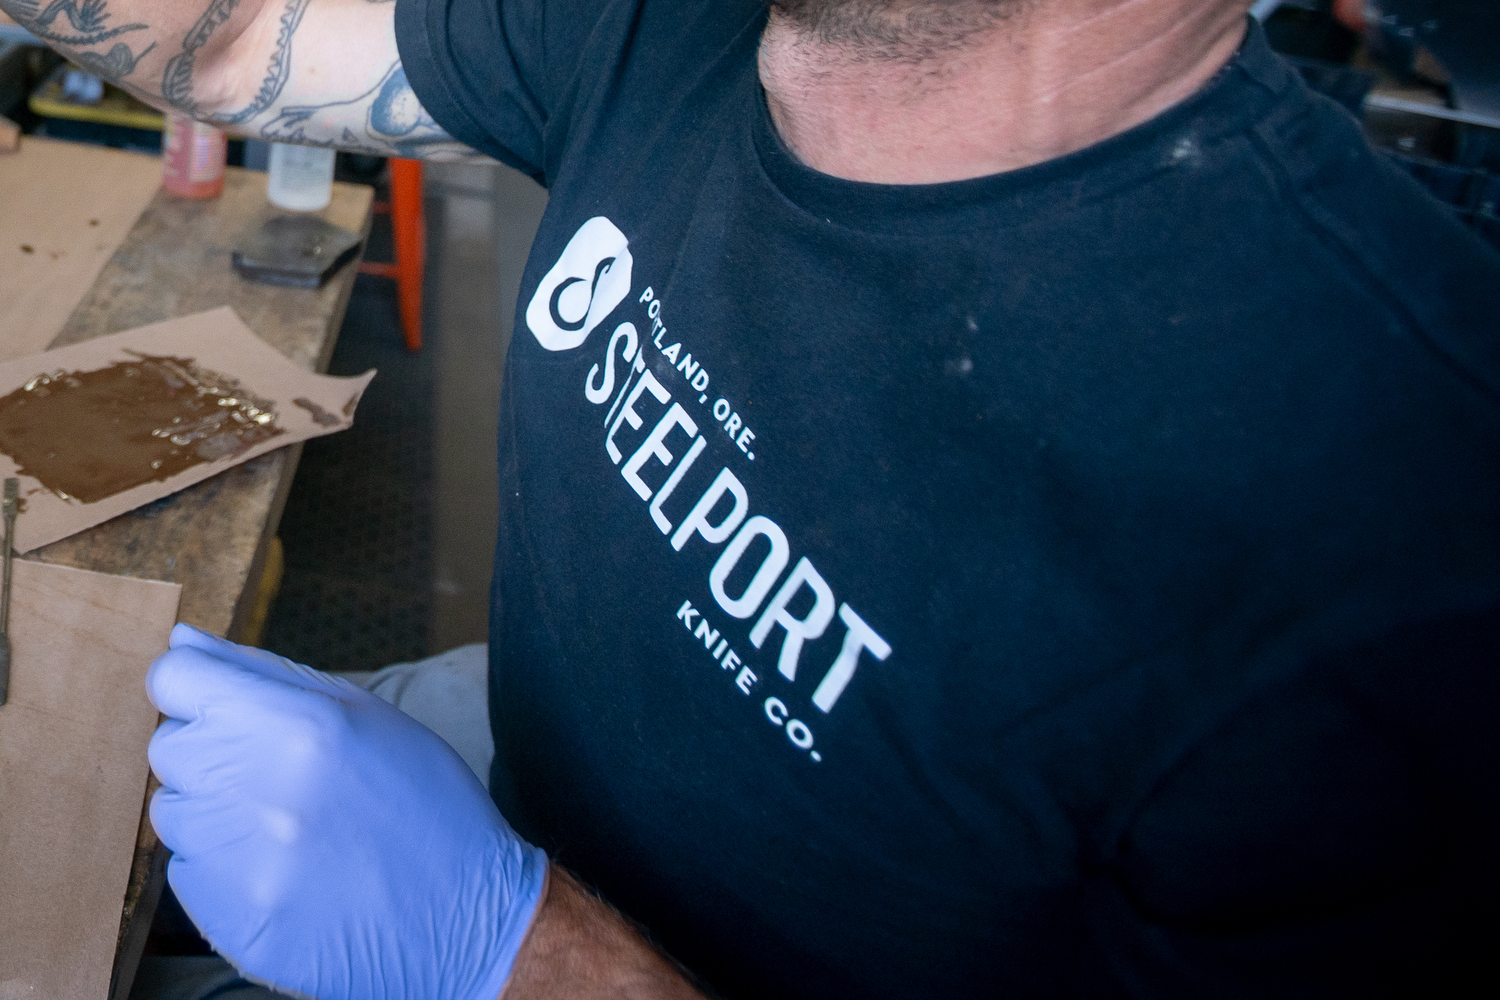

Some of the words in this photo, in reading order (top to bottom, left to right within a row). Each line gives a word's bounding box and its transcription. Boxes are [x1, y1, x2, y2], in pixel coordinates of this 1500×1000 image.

[712, 398, 756, 461] ORE.
[585, 321, 892, 714] STEELPORT
[676, 599, 758, 696] KNIFE
[764, 696, 822, 762] CO.
